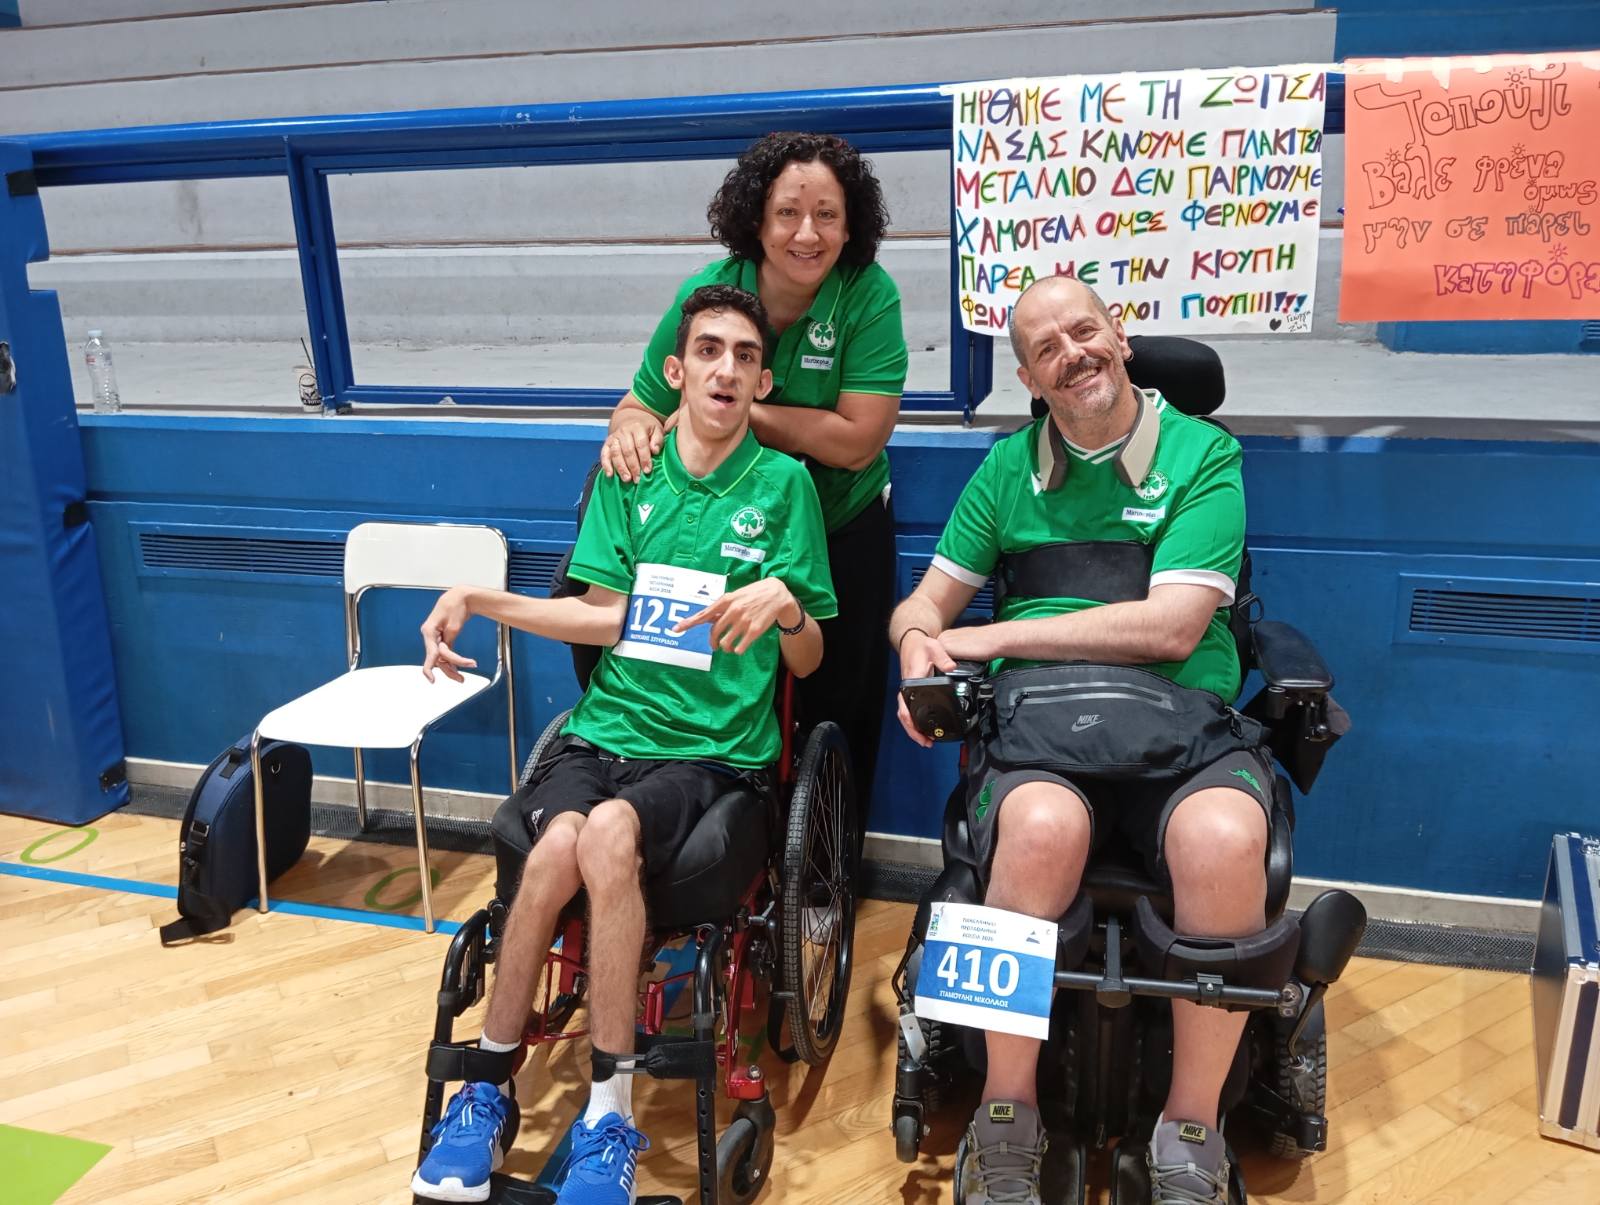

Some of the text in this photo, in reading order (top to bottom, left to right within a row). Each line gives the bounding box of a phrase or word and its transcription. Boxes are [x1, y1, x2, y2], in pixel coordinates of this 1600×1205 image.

[959, 86, 1062, 126] ΗΡΘΑΜΕ
[1079, 82, 1126, 123] ΜΕ
[1139, 79, 1183, 120] ΤΗ
[957, 127, 1323, 164] ΝΑ ΣΑΣ ΚΑΝΟΥΜΕ ΠΛΑΚΙΤΣΑ
[956, 164, 1323, 209] ΜΕΤΑΛΛΙΟ ΔΕΝ ΠΑΙΡΝΟΥΜΕ
[956, 199, 1318, 256] ΧΑΜΟΓΕΛΑ ΟΜΩΣ ΦΕΡΝΟΥΜΕ
[1445, 215, 1490, 242] σε
[960, 255, 1037, 294] ΠΑΡΕΑ
[1110, 257, 1170, 286] ΤΗΝ
[1190, 243, 1297, 280] ΚΙΟΥΠΗ
[630, 597, 690, 637] 125
[1077, 714, 1101, 725] NIKE
[936, 945, 1020, 997] 410
[974, 995, 1009, 1007] ΝΙΚΟΛΑΟΣ
[992, 1105, 1012, 1116] NIKE
[1182, 1124, 1204, 1137] NIKE
